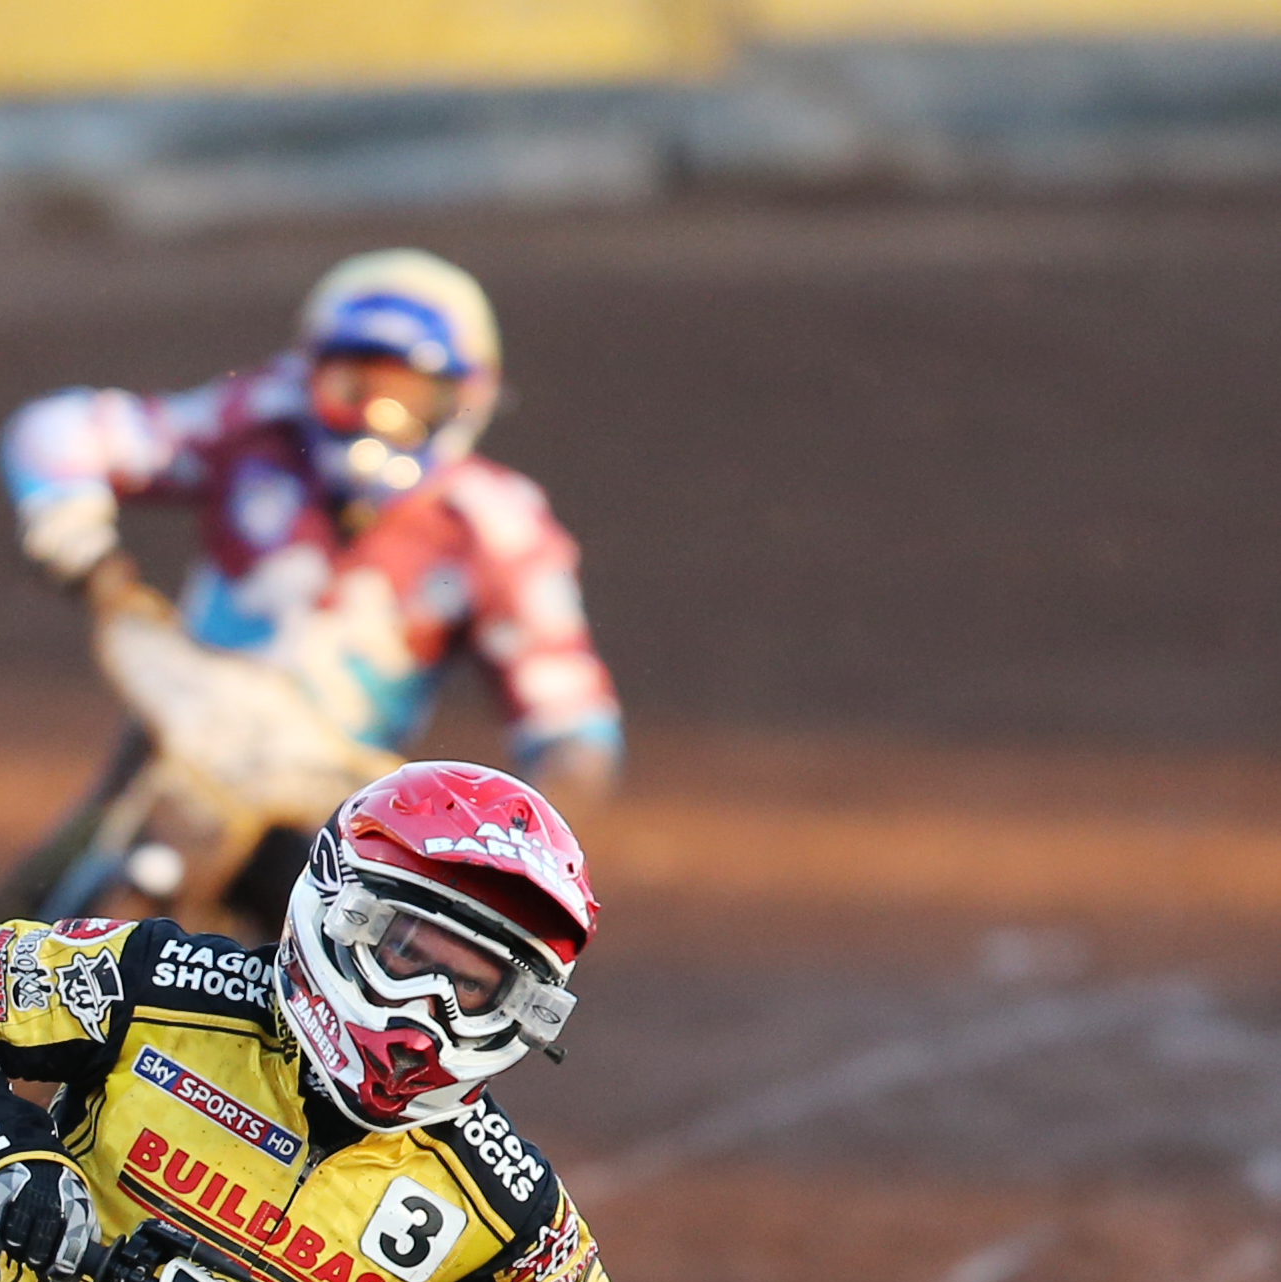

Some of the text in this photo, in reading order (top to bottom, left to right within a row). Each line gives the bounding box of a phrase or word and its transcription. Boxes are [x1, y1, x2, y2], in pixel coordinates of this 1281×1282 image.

[297, 996, 341, 1067] BARBERS
[314, 1001, 338, 1036] AL'S
[140, 1054, 295, 1157] sky SPORTS HD
[470, 1098, 544, 1182] AGON
[379, 1196, 443, 1268] 3
